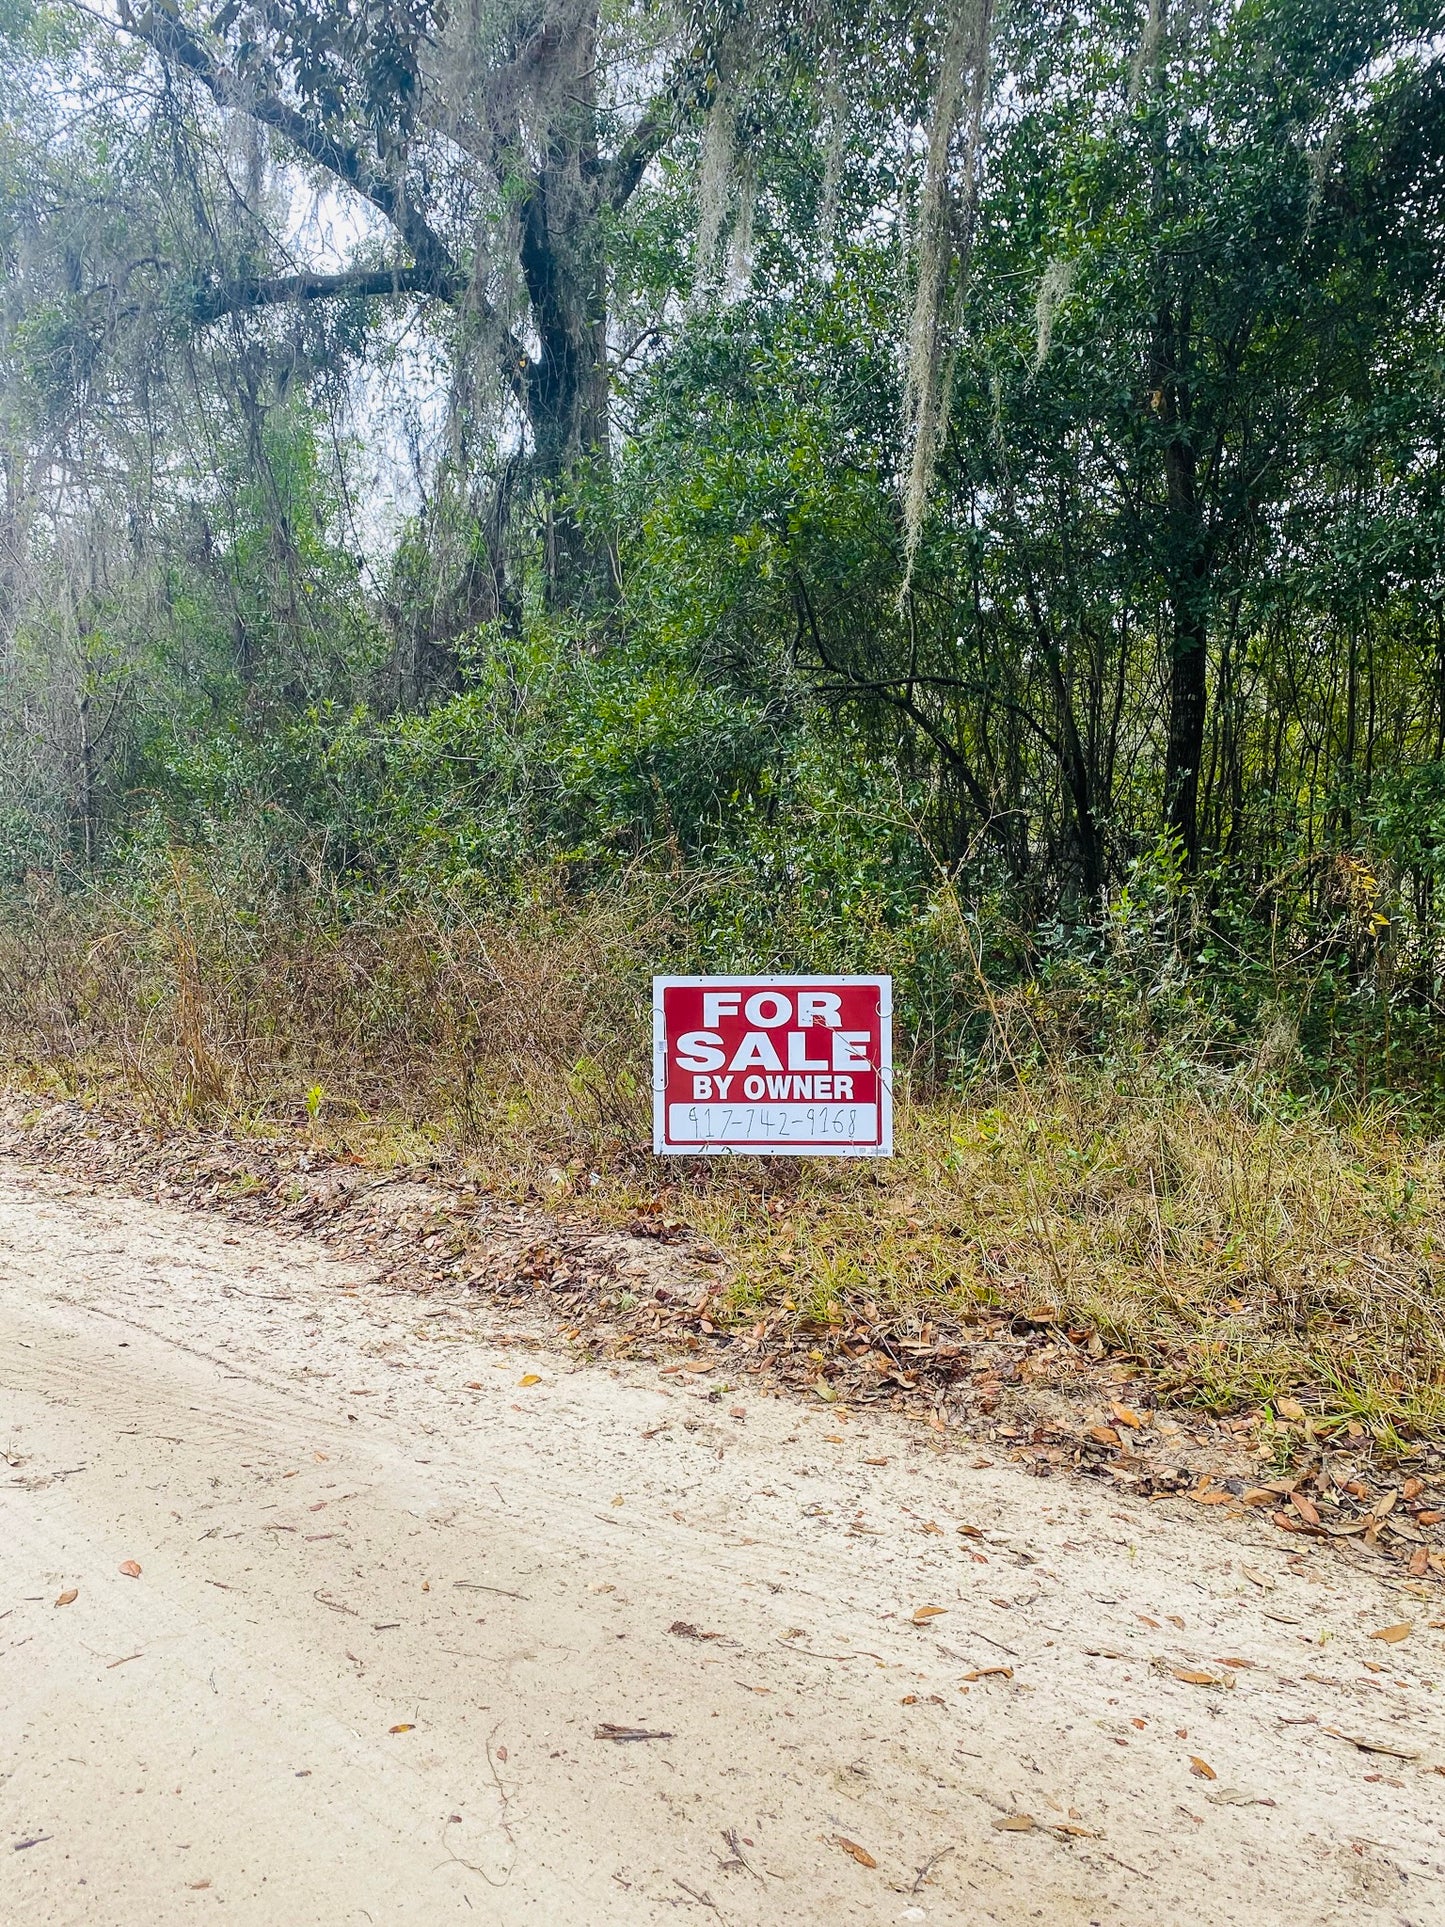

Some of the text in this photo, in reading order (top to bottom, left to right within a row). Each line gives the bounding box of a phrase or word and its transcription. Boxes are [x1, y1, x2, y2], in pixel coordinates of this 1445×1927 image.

[703, 991, 842, 1028] FOR
[675, 1031, 872, 1072] SALE
[693, 1075, 854, 1100] BY OWNER
